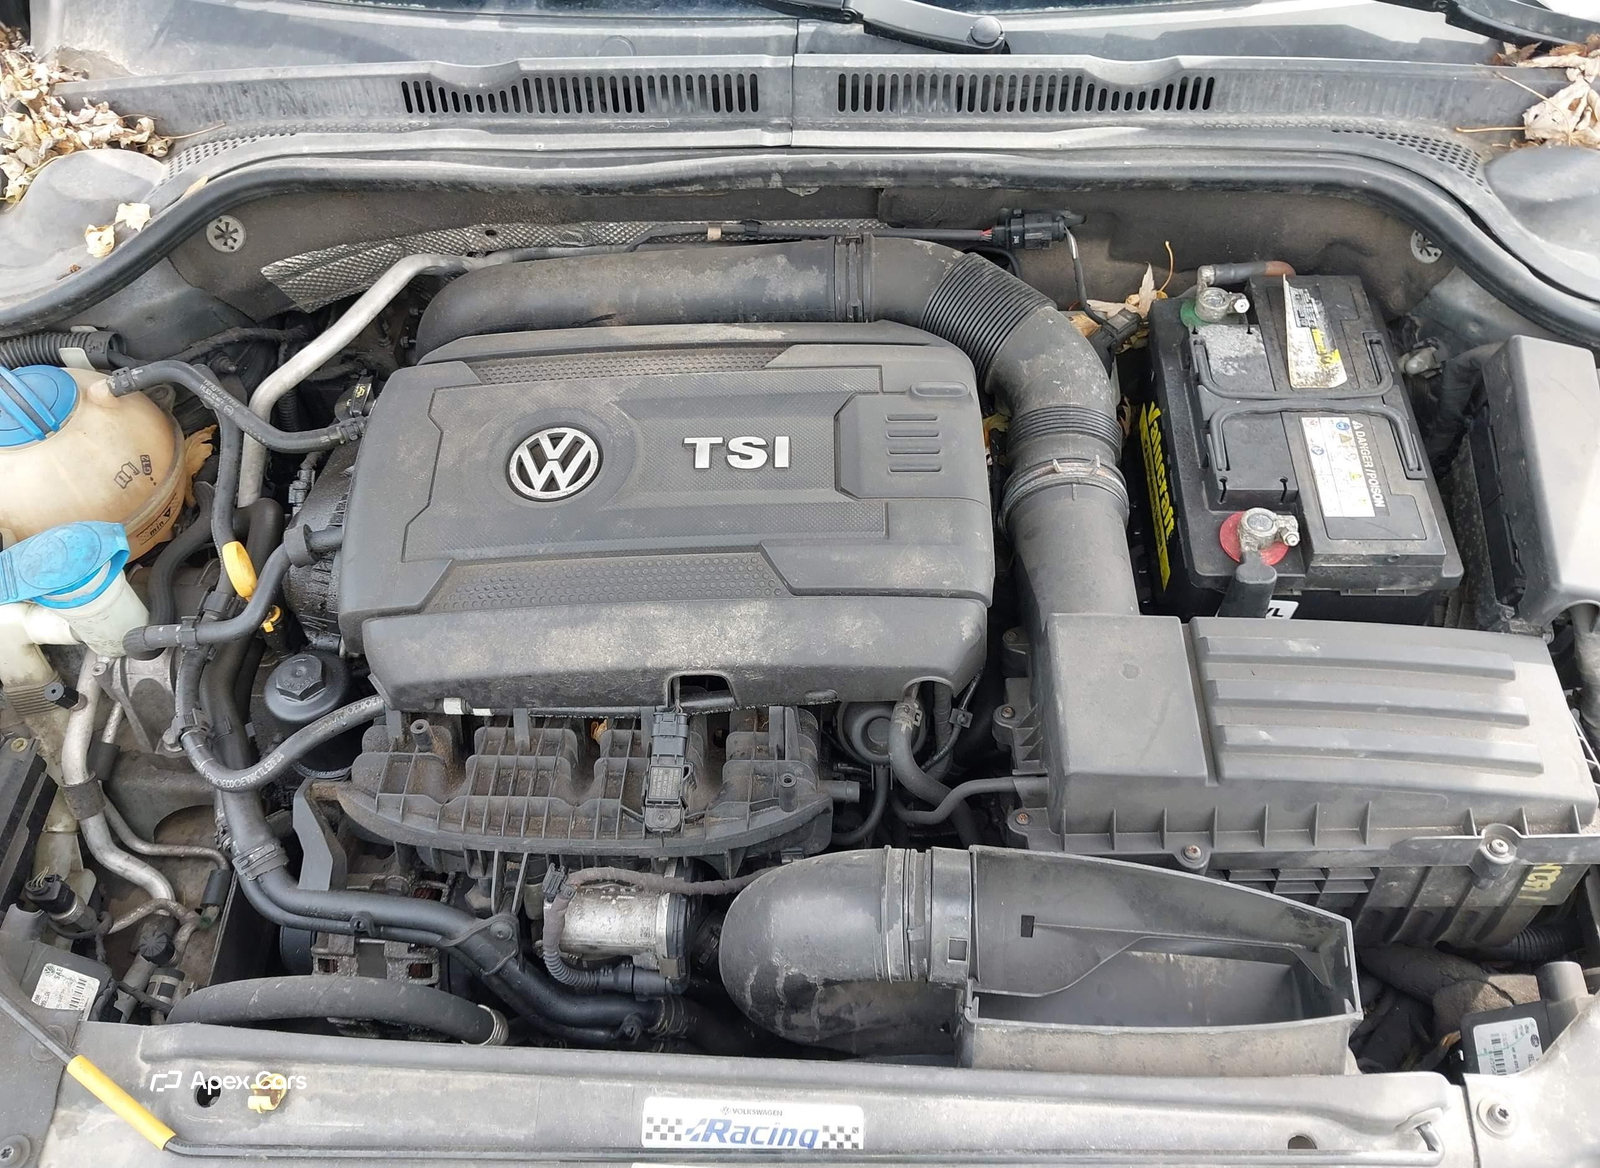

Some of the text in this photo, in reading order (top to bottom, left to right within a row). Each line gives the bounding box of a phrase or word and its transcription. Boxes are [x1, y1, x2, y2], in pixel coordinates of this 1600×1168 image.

[683, 435, 791, 470] TSI
[1148, 400, 1175, 544] Valucraft
[149, 520, 165, 536] min
[732, 1107, 783, 1117] VOLKSWAGEN
[701, 1118, 820, 1149] Racing
